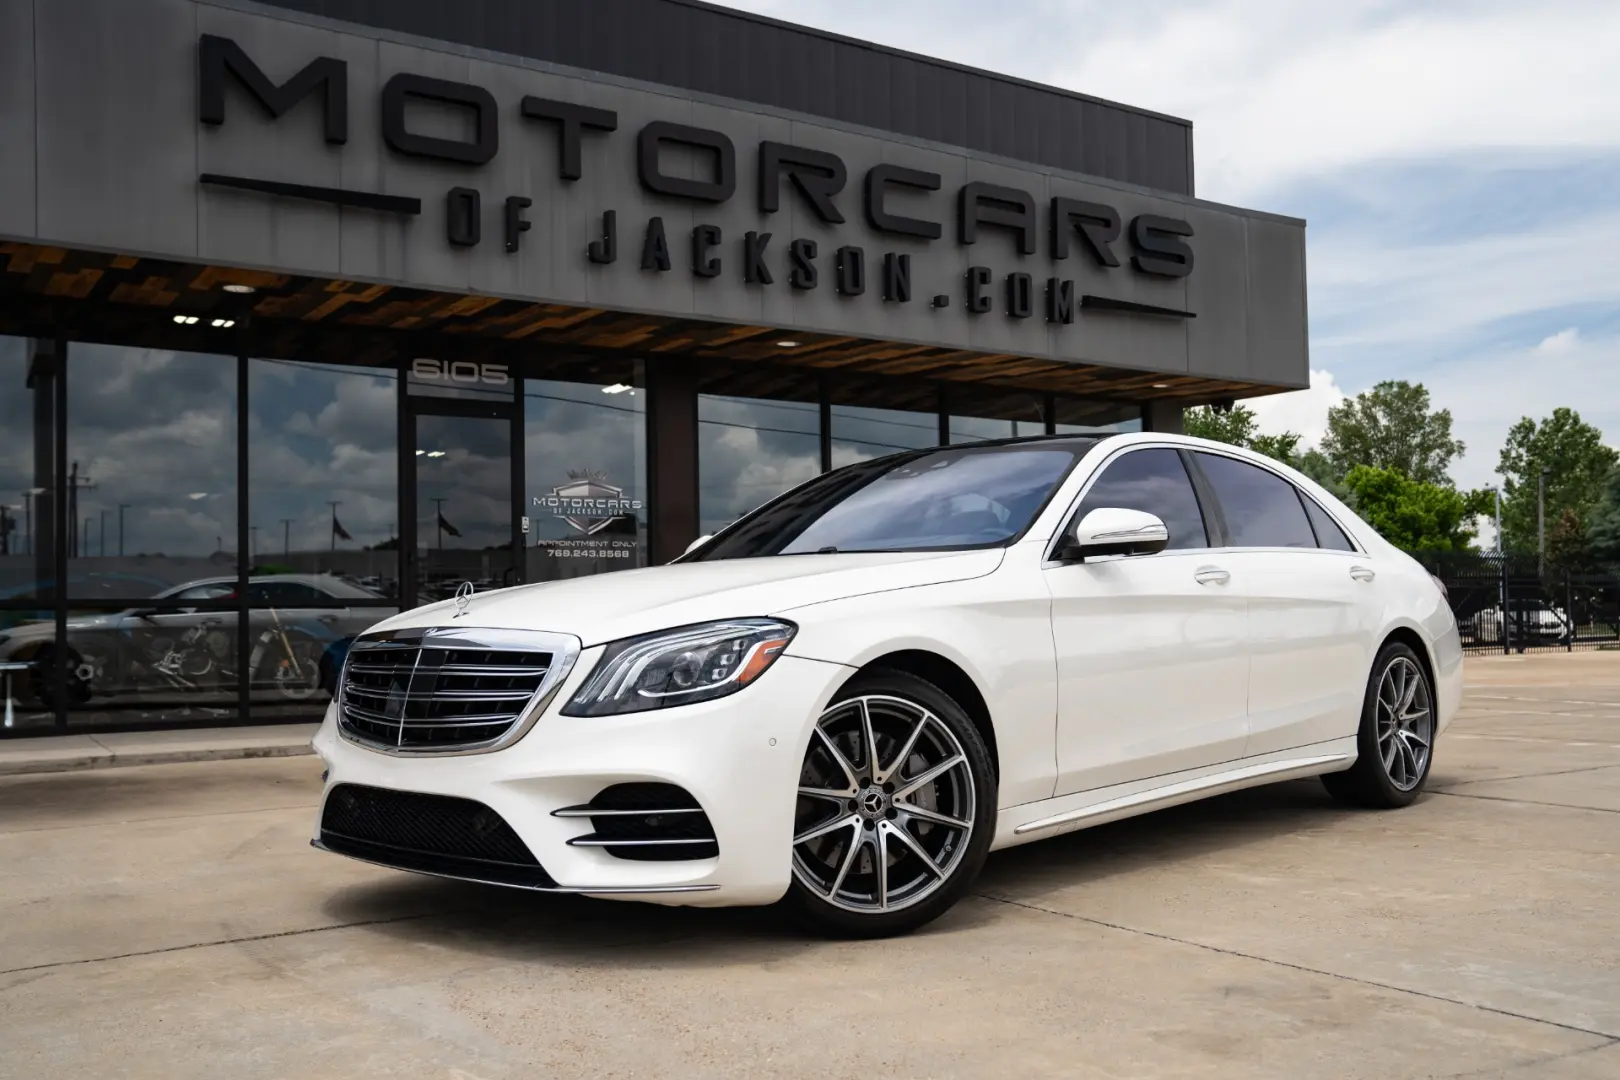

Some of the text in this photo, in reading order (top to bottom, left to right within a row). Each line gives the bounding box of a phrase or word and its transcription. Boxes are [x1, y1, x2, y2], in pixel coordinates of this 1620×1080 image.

[199, 33, 1195, 278] MOTORCARS
[446, 186, 532, 253] OF
[412, 358, 509, 385] 6105
[533, 497, 642, 509] MOTORCARS
[553, 507, 562, 515] OF
[538, 540, 609, 548] APPOINTMENT
